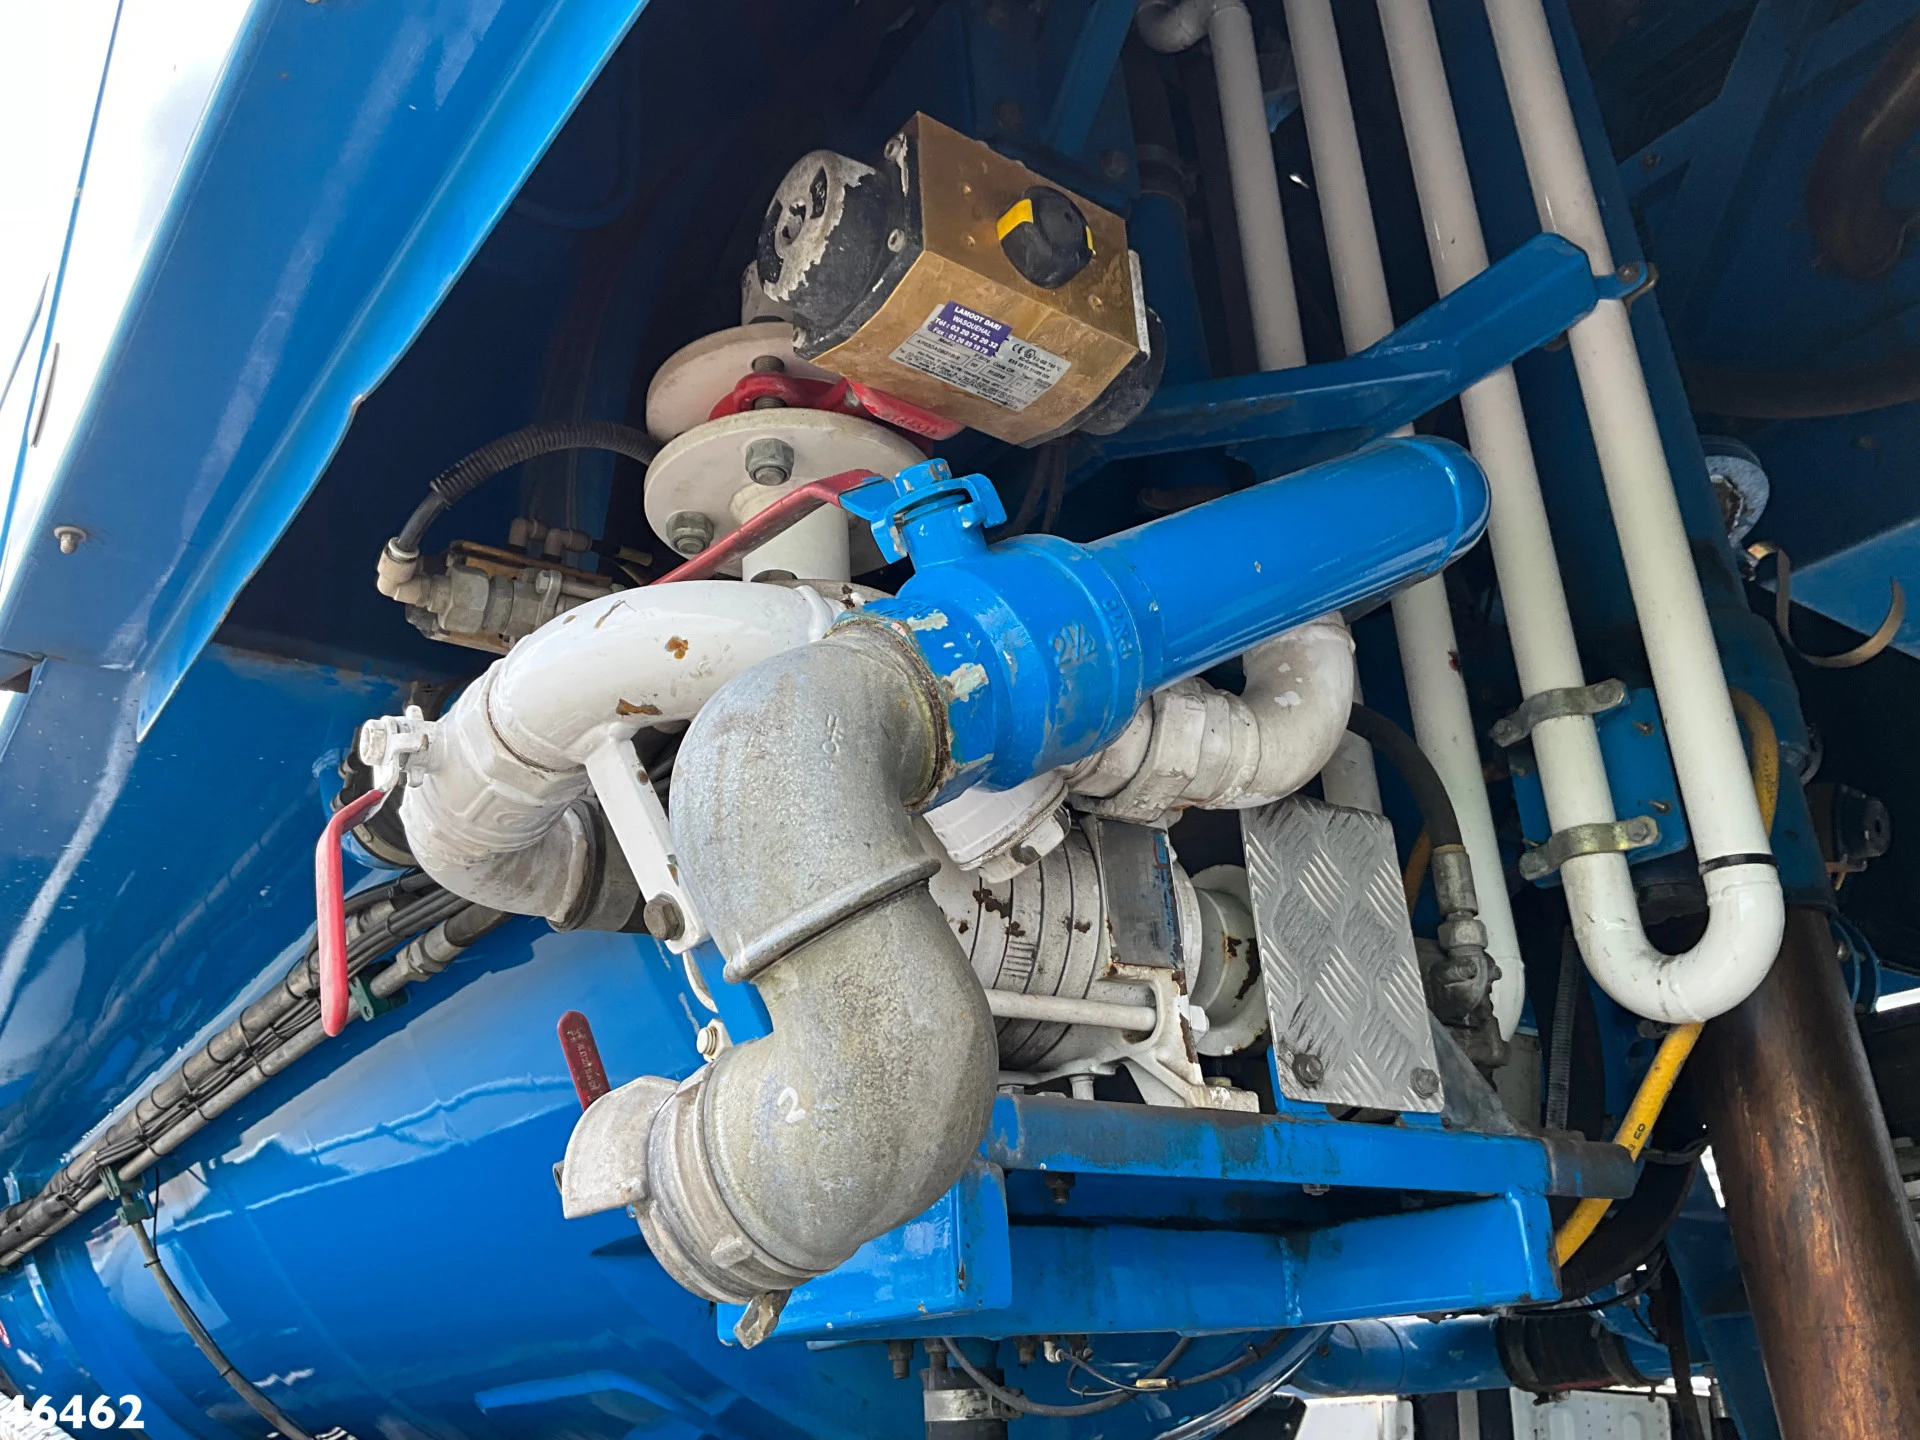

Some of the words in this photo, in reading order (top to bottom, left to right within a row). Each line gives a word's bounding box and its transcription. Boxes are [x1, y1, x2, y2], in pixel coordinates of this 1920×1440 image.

[952, 315, 991, 337] WASQUEHAL
[953, 306, 984, 324] LAMOOT
[984, 319, 1002, 331] DARI
[932, 327, 944, 336] Fax
[948, 333, 956, 341] 03
[956, 336, 964, 344] 20
[964, 339, 972, 348] 89
[973, 343, 980, 351] 19
[980, 346, 989, 354] 79
[934, 317, 946, 328] Tél
[950, 325, 960, 333] 03
[960, 329, 970, 337] 20
[970, 333, 979, 341] 72
[979, 337, 989, 345] 20
[989, 341, 999, 349] 32
